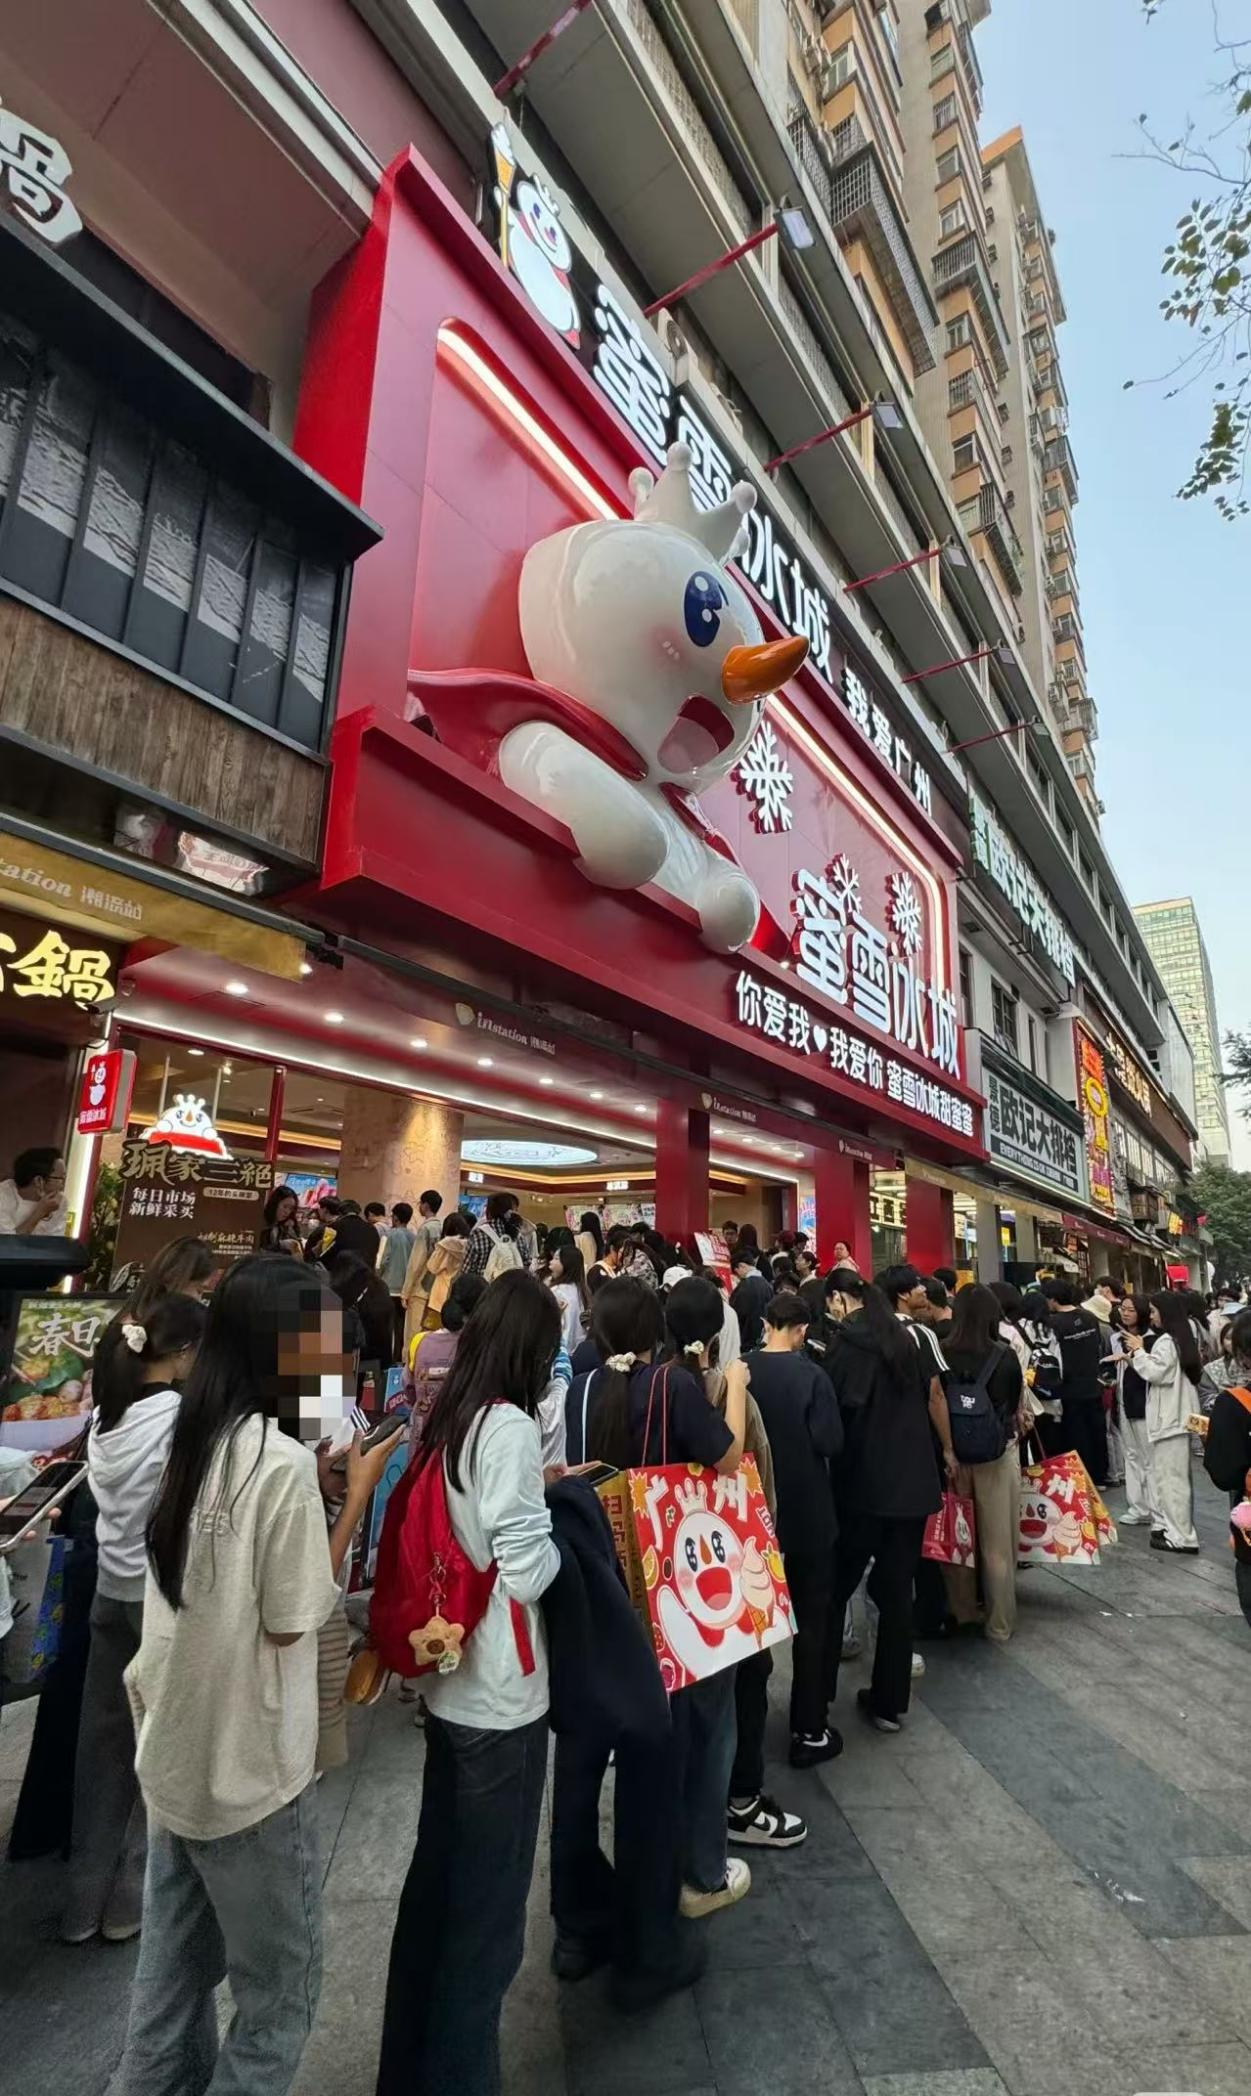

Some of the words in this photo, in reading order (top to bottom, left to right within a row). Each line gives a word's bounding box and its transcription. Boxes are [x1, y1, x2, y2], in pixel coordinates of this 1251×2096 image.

[843, 665, 932, 818] 我爱广州
[0, 929, 116, 1011] 鍋
[796, 867, 961, 1081] 蜜雪冰城
[735, 970, 811, 1055] 你爱我
[829, 1026, 884, 1090] 我爱你
[886, 1059, 974, 1137] 蜜雪冰城甜蜜蜜
[999, 1083, 1079, 1176] 欧记大排档
[129, 1201, 195, 1220] 新鲜采买
[132, 1186, 197, 1206] 每日市场
